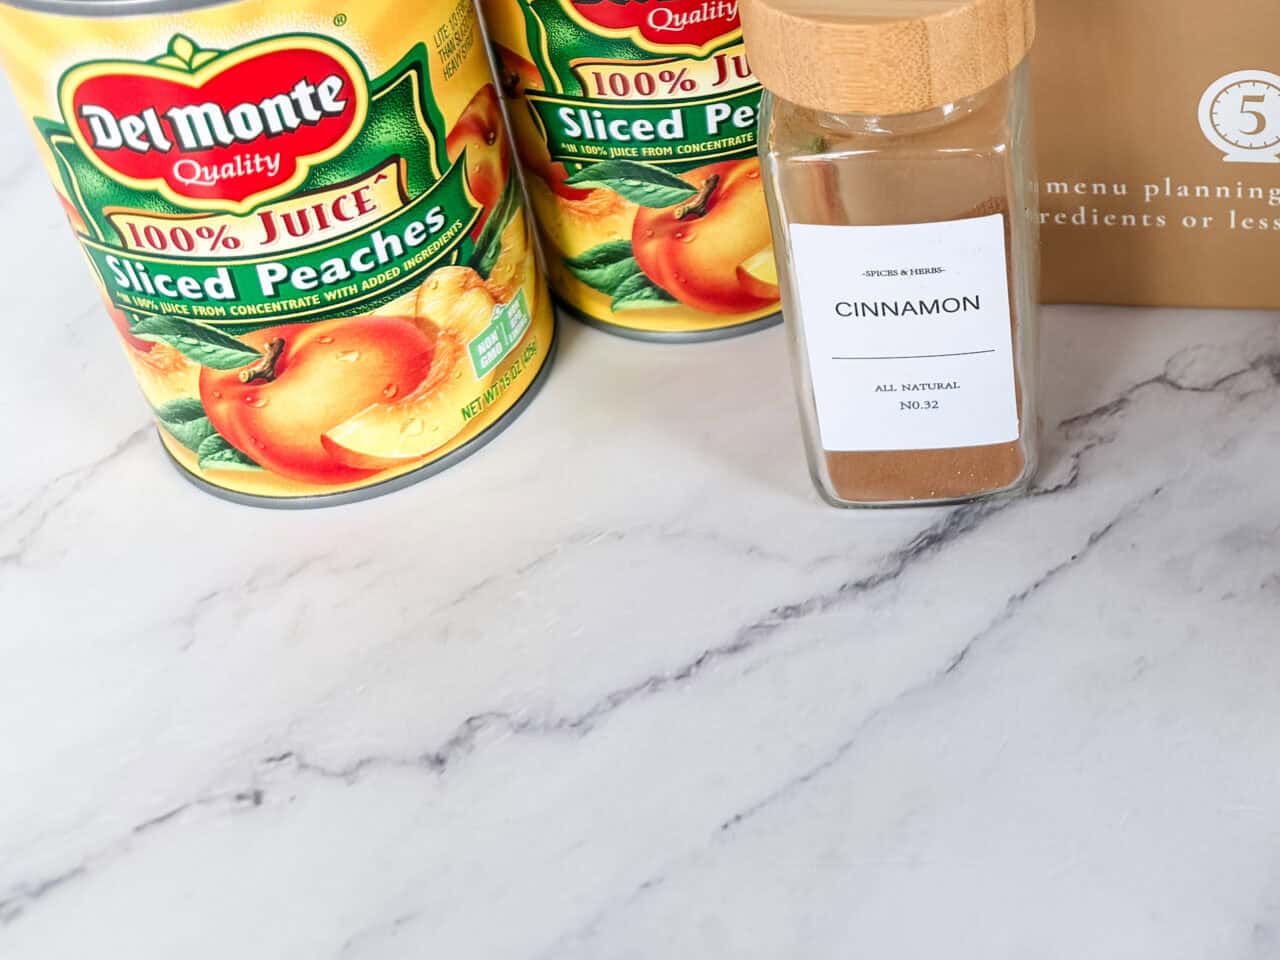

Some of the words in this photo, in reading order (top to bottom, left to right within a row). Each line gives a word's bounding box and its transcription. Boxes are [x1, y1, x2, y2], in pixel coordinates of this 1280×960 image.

[647, 0, 738, 32] Quality
[592, 67, 697, 98] 100%
[79, 103, 172, 153] Del
[167, 74, 348, 153] Monte
[558, 106, 684, 142] Sliced
[705, 102, 760, 135] Pe
[1237, 93, 1268, 136] 5
[579, 144, 607, 157] 100%
[609, 145, 638, 158] JUICE
[642, 145, 673, 157] FROM
[676, 132, 753, 154] CONCENTRATE
[173, 151, 281, 186] Quality
[1044, 180, 1129, 198] menu
[1039, 206, 1168, 229] redients
[1181, 213, 1214, 230] or
[125, 220, 241, 252] 100%
[105, 254, 236, 301] Sliced
[256, 205, 446, 297] Peaches
[160, 301, 190, 317] JUICE
[193, 303, 226, 317] FROM
[230, 294, 320, 317] CONCENTRATE
[324, 282, 358, 302] WITH
[361, 266, 401, 292] ADDED
[402, 219, 463, 271] INGREDIENTS
[834, 294, 981, 318] CINNAMON
[461, 396, 483, 421] NET
[483, 382, 500, 405] WT
[874, 383, 897, 393] ALL
[901, 381, 960, 392] NATURAL
